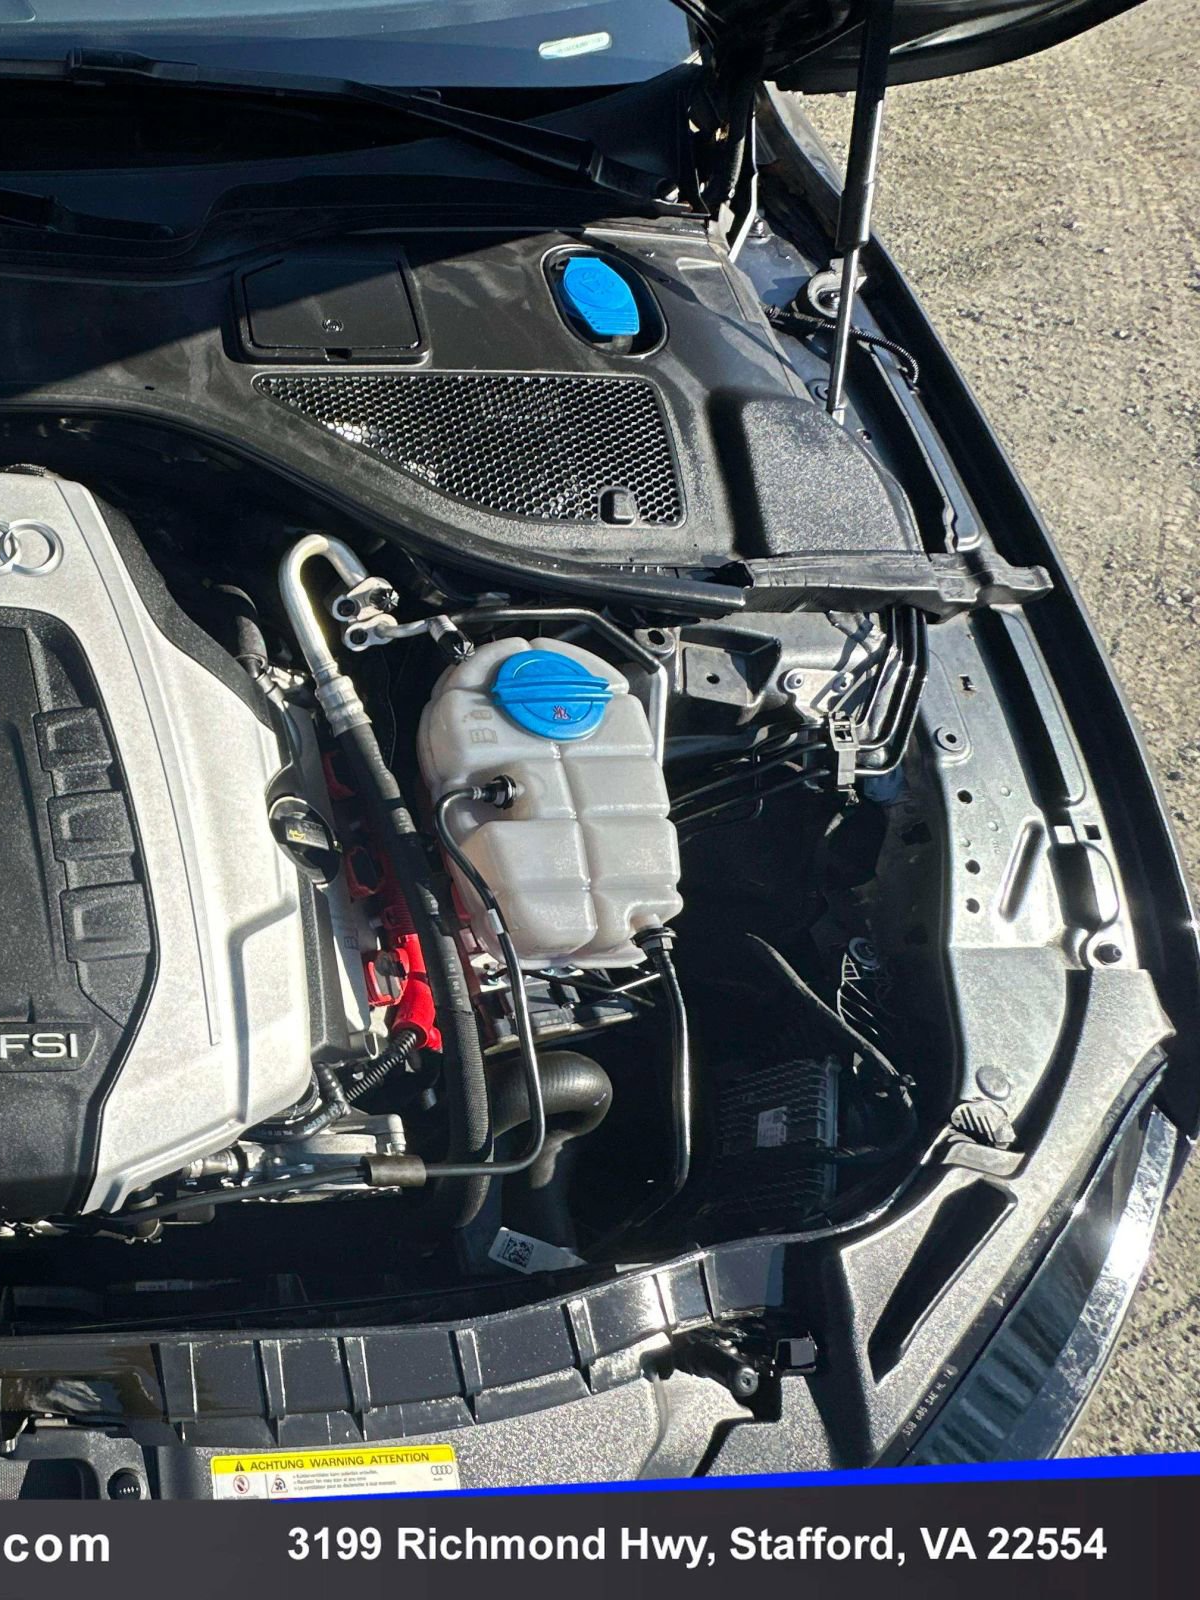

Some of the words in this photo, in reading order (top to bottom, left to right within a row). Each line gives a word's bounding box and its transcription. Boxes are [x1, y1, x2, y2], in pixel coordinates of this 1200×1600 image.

[250, 1459, 305, 1471] ACHTUNG
[309, 1455, 364, 1468] WARNING
[370, 1452, 430, 1465] ATTENTION
